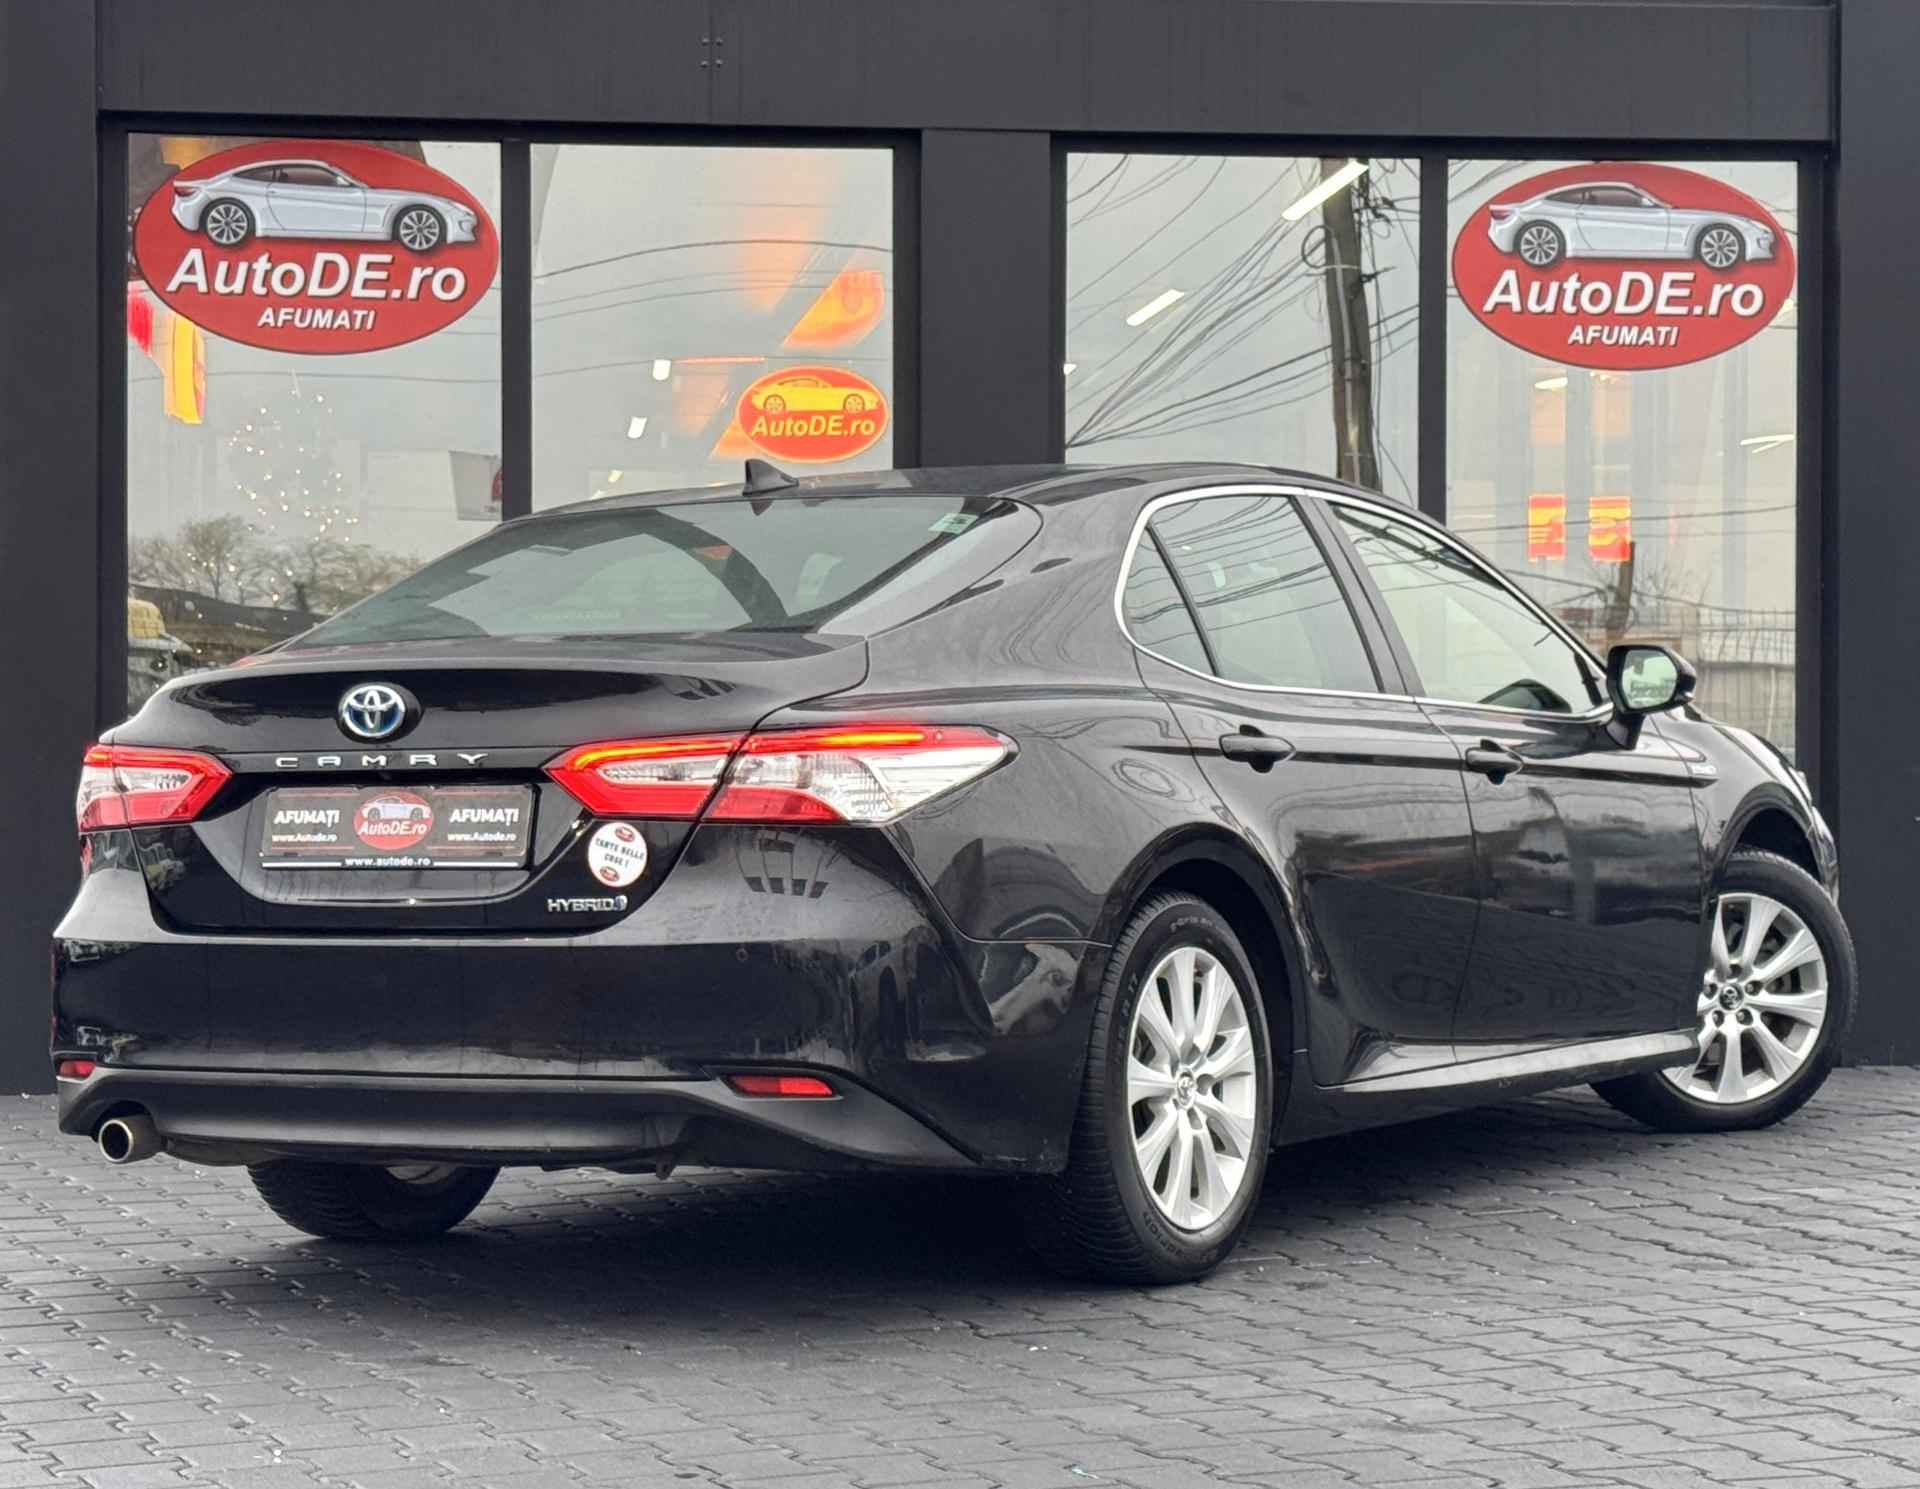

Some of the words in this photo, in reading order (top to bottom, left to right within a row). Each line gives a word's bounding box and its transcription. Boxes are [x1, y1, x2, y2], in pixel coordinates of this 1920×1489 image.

[166, 248, 466, 301] AutoDE.ro
[1483, 269, 1764, 317] AutoDE.ro
[257, 307, 376, 331] AFUMATI
[1567, 325, 1679, 347] AFUMATI
[751, 415, 876, 437] AutoDE.ro
[275, 752, 489, 769] CAMRY
[358, 820, 428, 837] AutoDE.ro
[345, 856, 431, 867] www.autode.ro
[620, 844, 645, 861] BELLE
[547, 898, 615, 912] HYBRID
